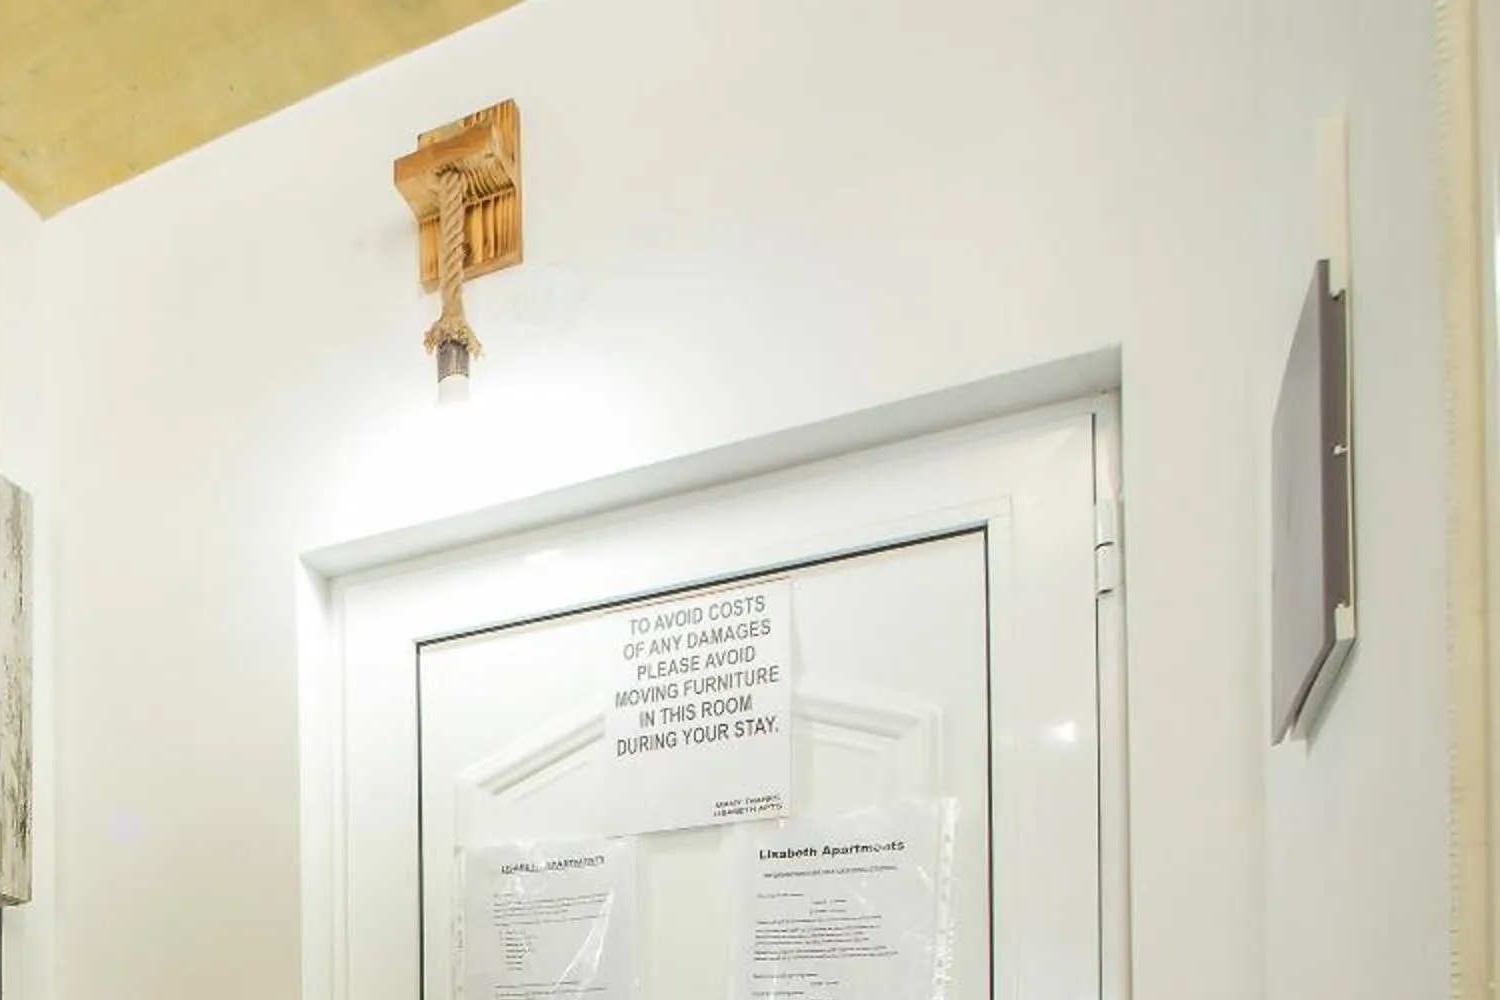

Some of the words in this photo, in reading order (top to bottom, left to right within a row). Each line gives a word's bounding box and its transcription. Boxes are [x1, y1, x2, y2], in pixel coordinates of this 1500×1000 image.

[629, 617, 650, 635] TO
[653, 607, 703, 631] AVOID
[708, 595, 766, 620] COSTS
[623, 641, 645, 661] OF
[649, 635, 683, 657] ANY
[687, 618, 771, 649] DAMAGES
[637, 655, 701, 681] PLEASE
[705, 645, 756, 669] AVOID
[615, 683, 679, 709] MOVING
[683, 665, 780, 697] FURNITURE
[639, 711, 655, 729] IN
[660, 703, 697, 725] THIS
[701, 694, 754, 719] ROOM
[616, 731, 678, 758] DURING
[682, 723, 730, 746] YOUR
[734, 715, 780, 738] STAY.
[821, 841, 905, 859] Apartments
